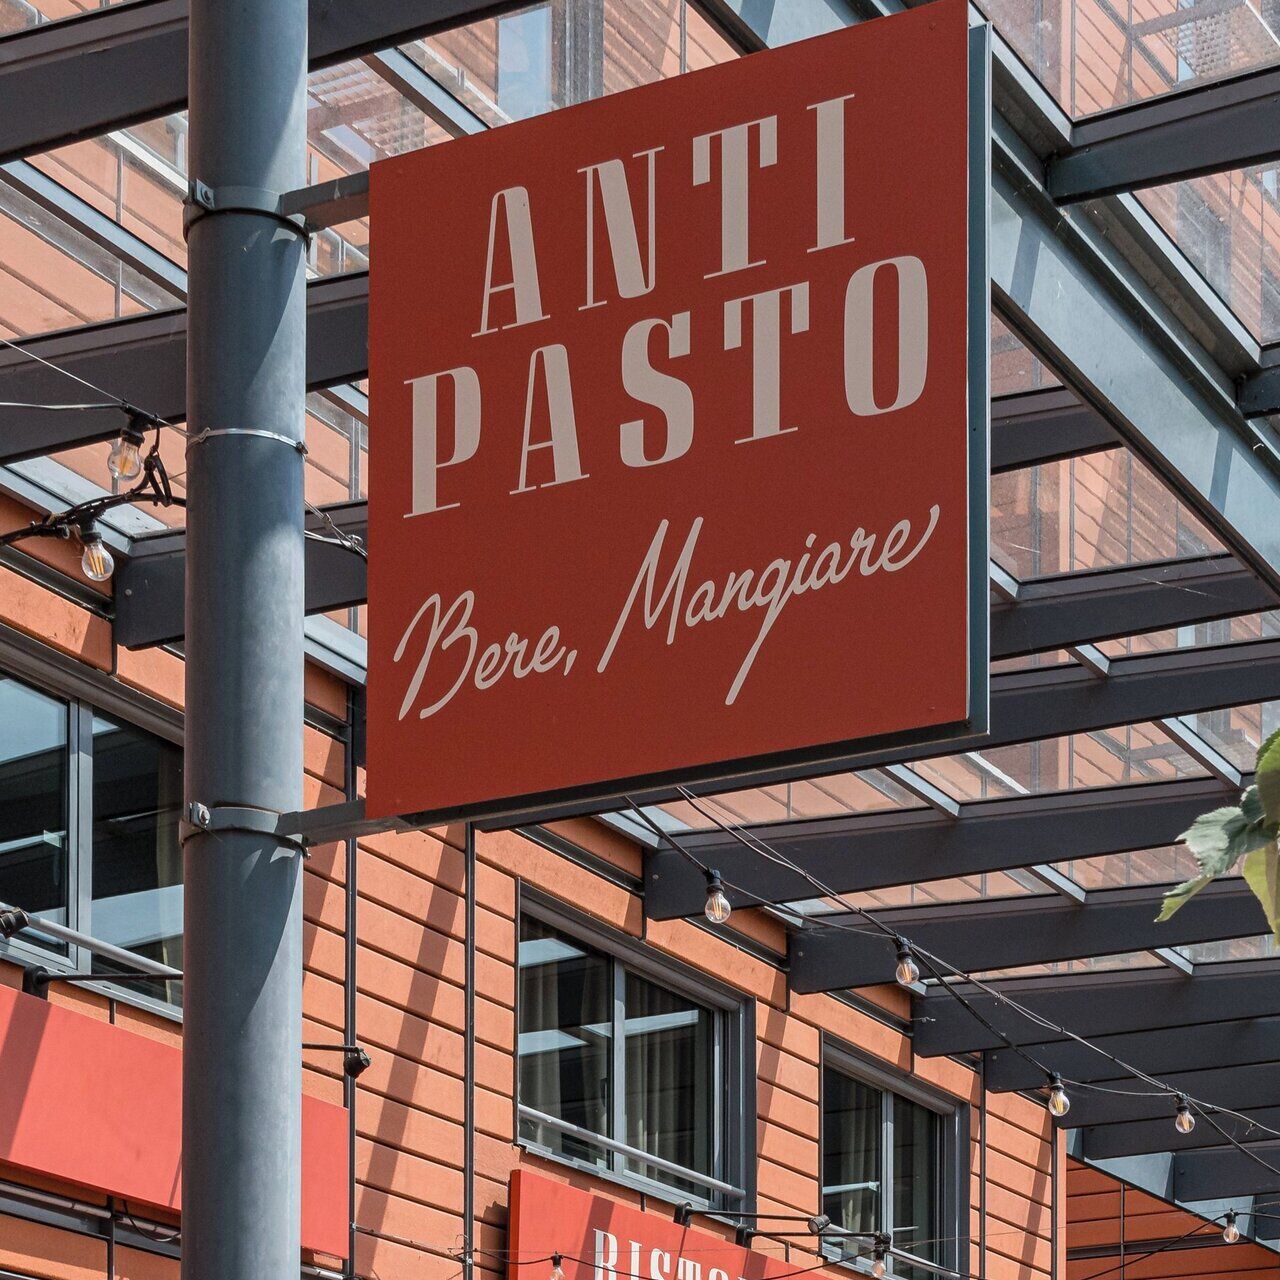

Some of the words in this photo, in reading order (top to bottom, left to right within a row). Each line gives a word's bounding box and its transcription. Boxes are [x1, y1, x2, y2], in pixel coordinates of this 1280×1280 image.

[471, 93, 856, 338] ANTI
[403, 255, 929, 519] PASTO
[393, 590, 577, 721] Bere,
[596, 504, 940, 706] Mangiare
